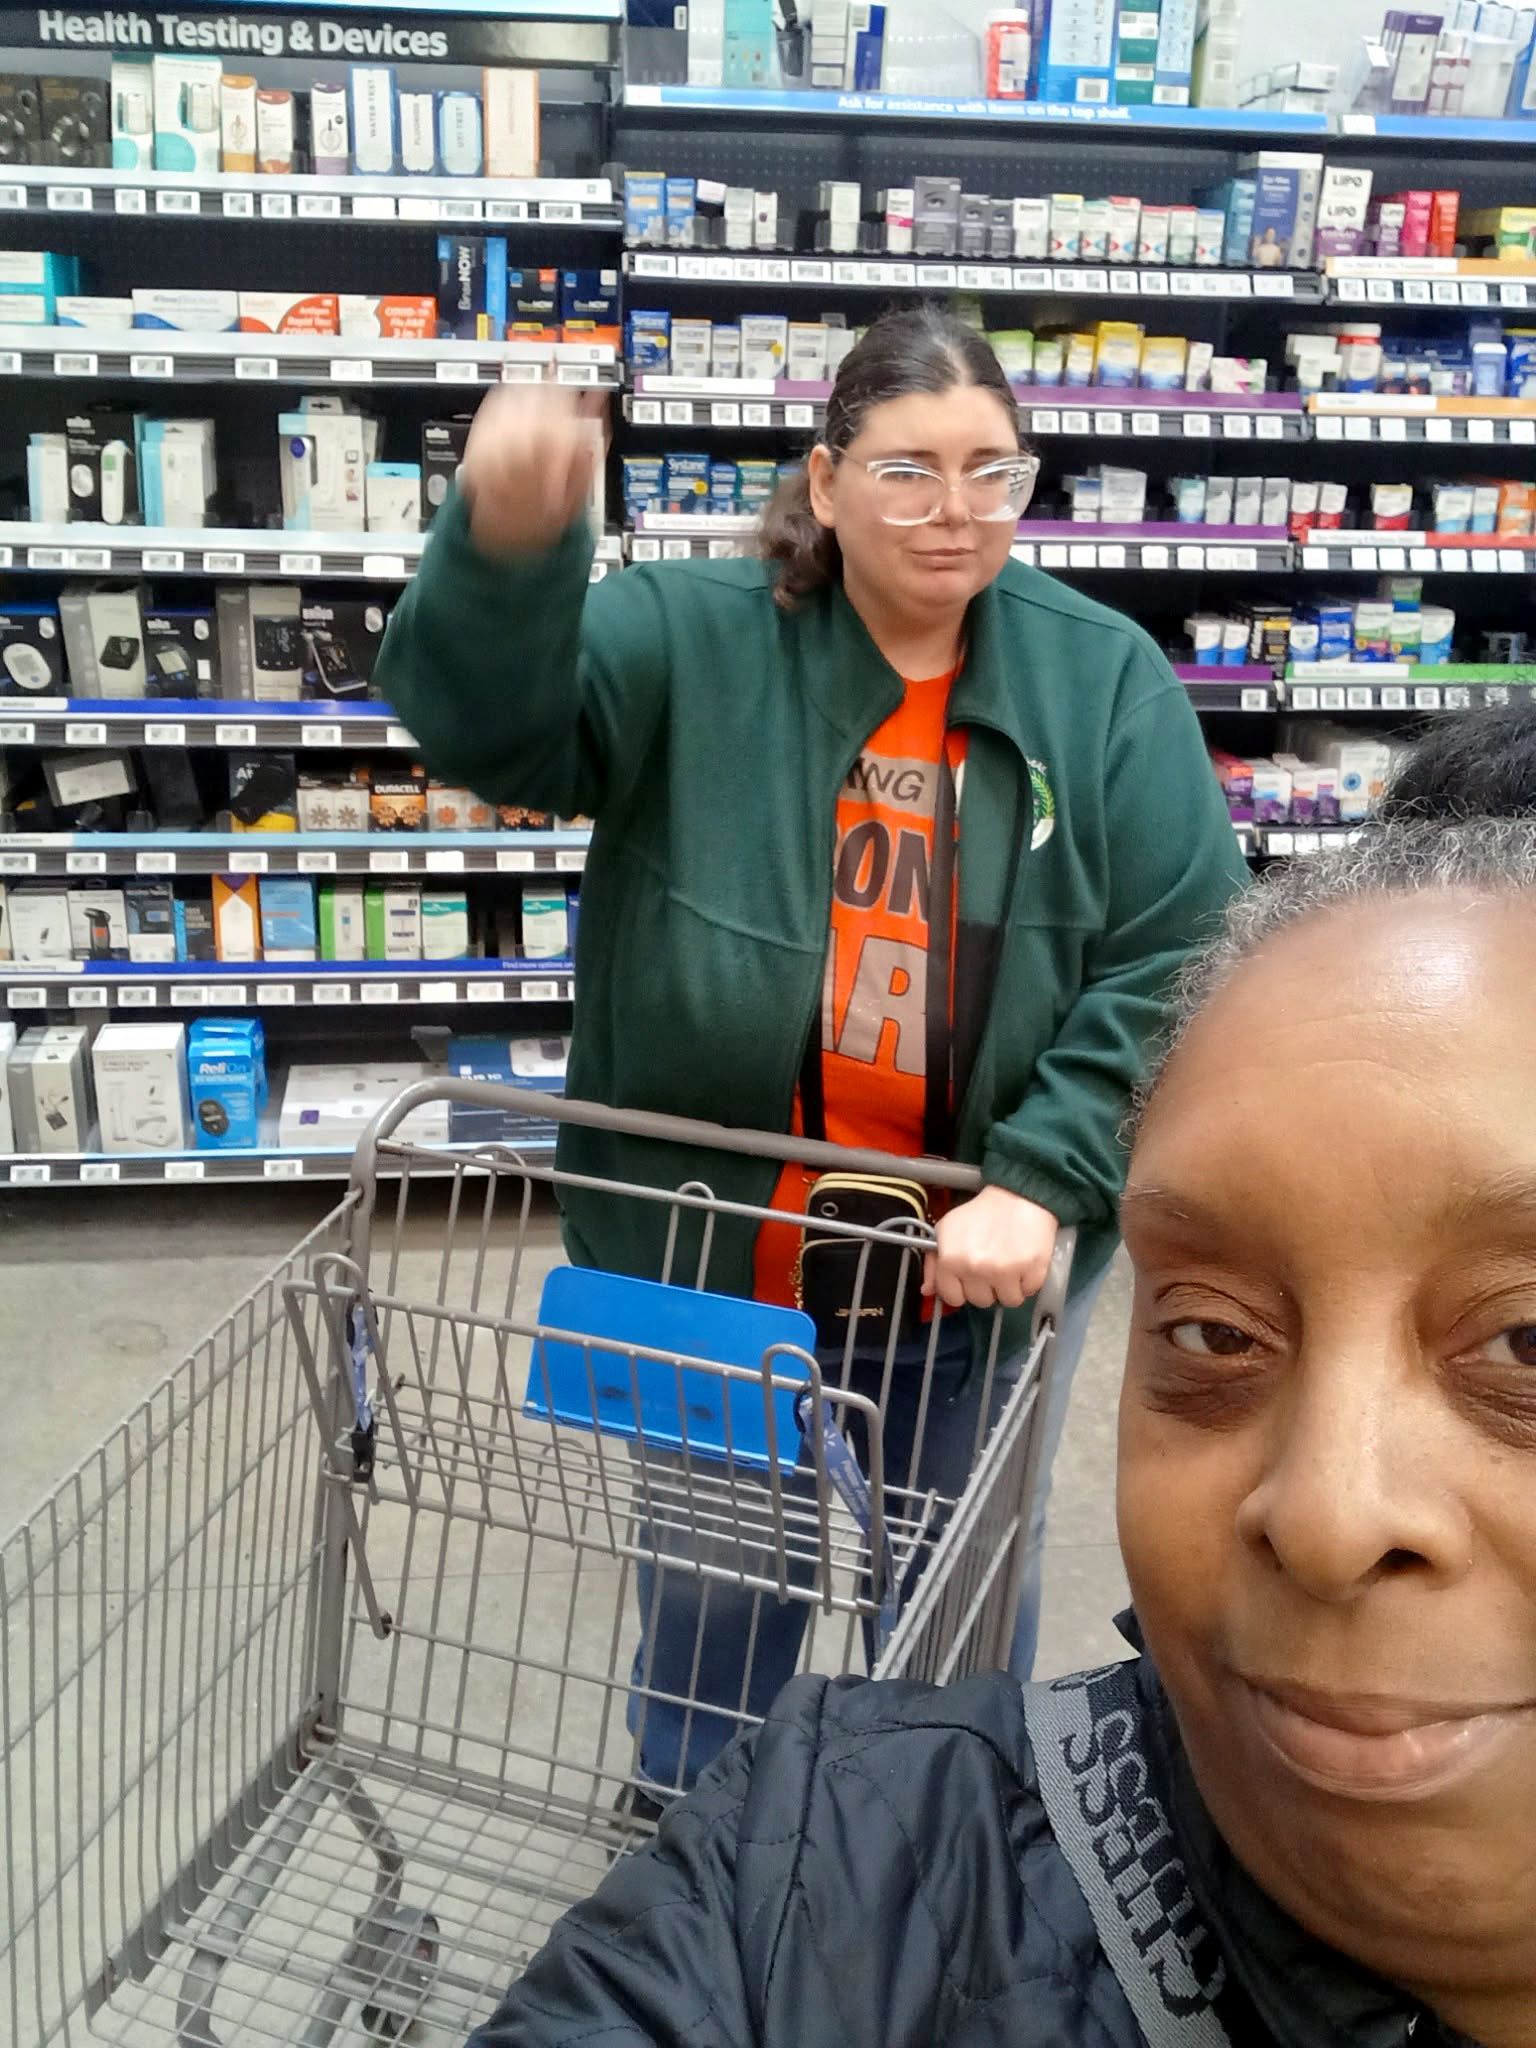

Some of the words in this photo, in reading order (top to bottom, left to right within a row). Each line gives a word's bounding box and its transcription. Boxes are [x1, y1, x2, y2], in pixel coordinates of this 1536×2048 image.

[38, 9, 152, 45] Health
[156, 14, 284, 56] Testing
[289, 20, 314, 51] &
[319, 21, 448, 57] Devices
[838, 95, 862, 109] Ask
[864, 96, 883, 109] for
[886, 99, 954, 112] assistance
[956, 101, 986, 113] with
[1026, 105, 1046, 116] on
[1046, 104, 1069, 117] the
[1071, 105, 1095, 120] top
[368, 106, 377, 138] WATER
[375, 783, 421, 794] DURACELL
[199, 1062, 246, 1074] ReliOn
[1057, 1708, 1228, 2020] GUESS
